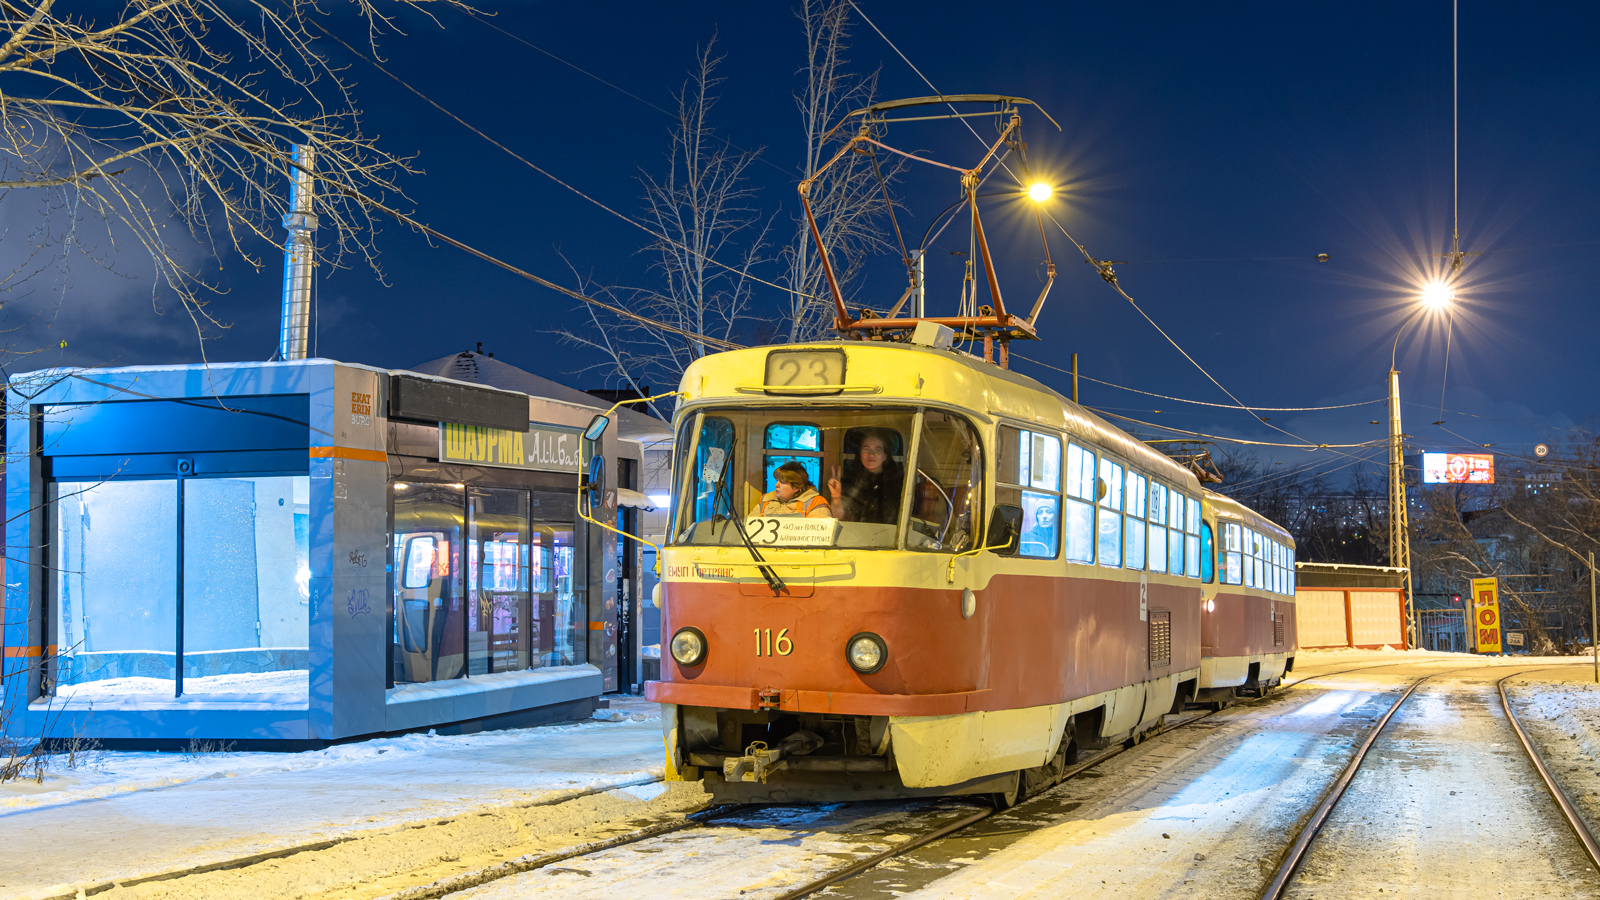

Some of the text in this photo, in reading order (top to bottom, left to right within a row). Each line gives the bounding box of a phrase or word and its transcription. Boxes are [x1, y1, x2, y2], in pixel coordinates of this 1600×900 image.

[779, 358, 829, 386] 23
[351, 392, 371, 404] EKAT
[351, 403, 371, 415] ERIN
[351, 414, 371, 426] BURG
[446, 421, 525, 465] ШАУРМА
[748, 519, 780, 545] 23
[667, 566, 689, 578] ЕМУП
[1141, 583, 1146, 605] 2
[1478, 590, 1499, 645] ЛОМ
[754, 628, 794, 657] 116
